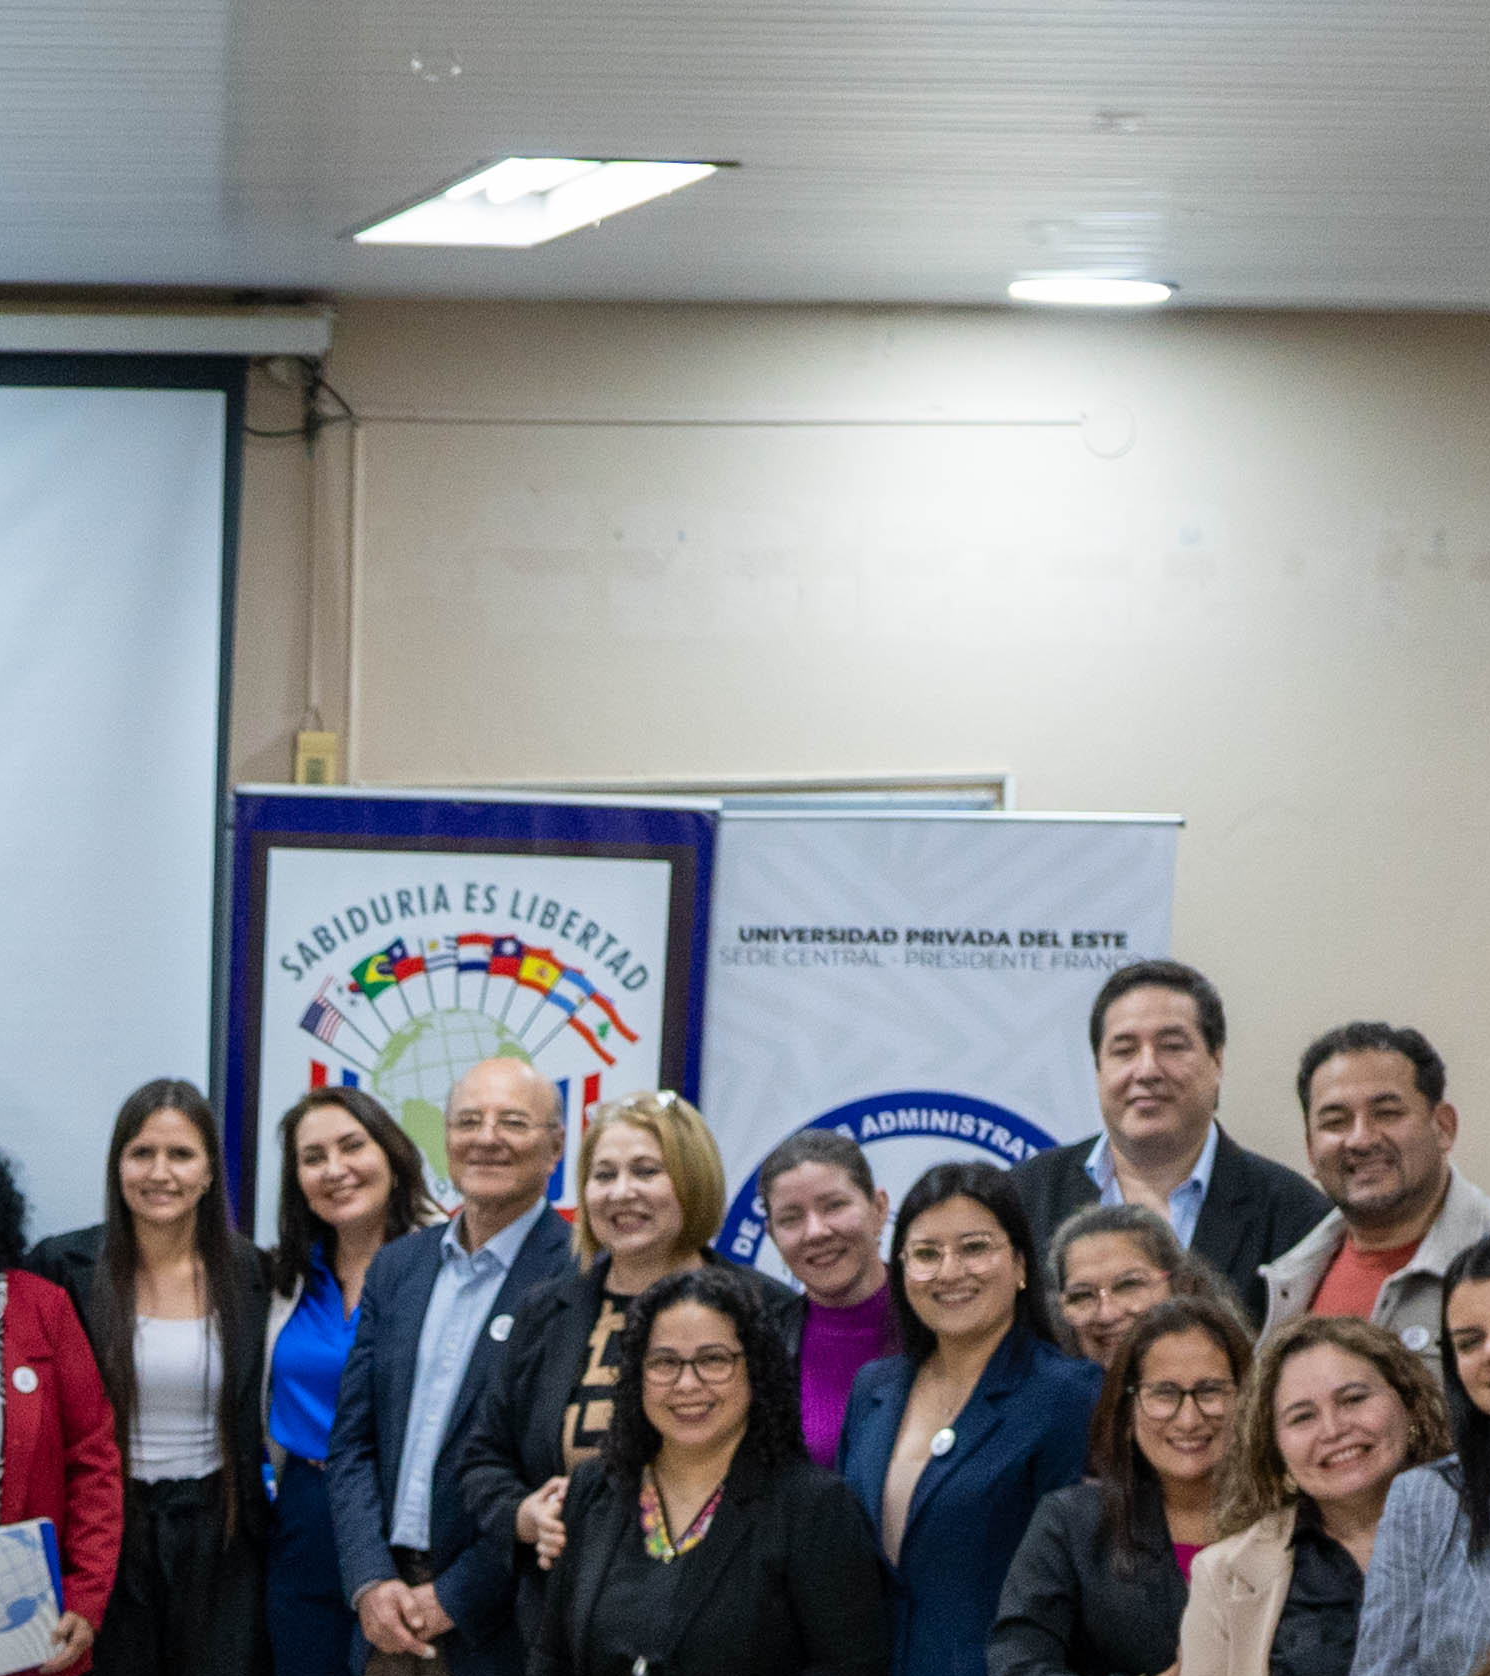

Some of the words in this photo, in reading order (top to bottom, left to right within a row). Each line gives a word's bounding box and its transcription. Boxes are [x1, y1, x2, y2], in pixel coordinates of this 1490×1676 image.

[279, 883, 452, 982] SABIDURIA
[462, 882, 498, 915] ES
[509, 888, 651, 993] LIBERTAD
[739, 926, 899, 946] UNIVERSIDAD
[905, 928, 1014, 948] PRIVADA
[1019, 930, 1063, 949] DEL
[1070, 931, 1129, 950] ESTE
[720, 947, 776, 967] SEDE
[782, 948, 885, 968] CENTRAL
[904, 950, 1043, 970] PRESIDENTE
[730, 1216, 762, 1259] DE
